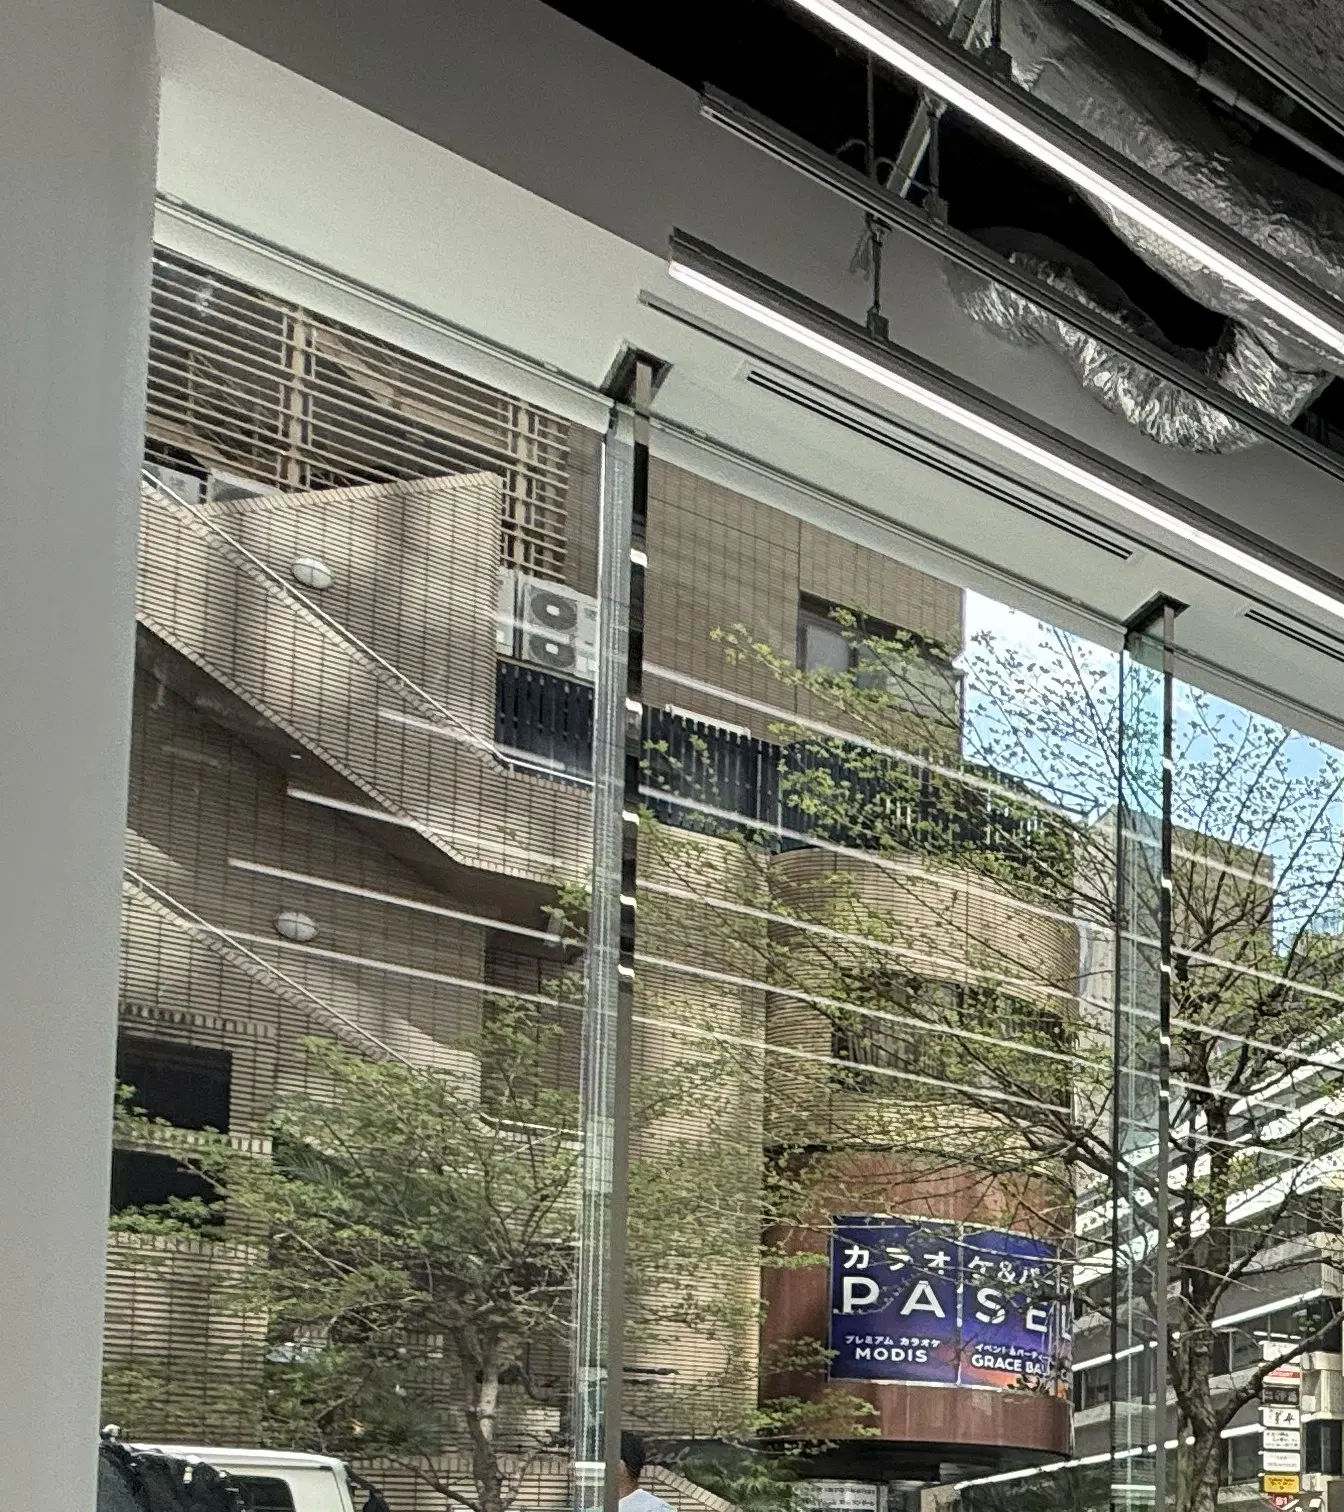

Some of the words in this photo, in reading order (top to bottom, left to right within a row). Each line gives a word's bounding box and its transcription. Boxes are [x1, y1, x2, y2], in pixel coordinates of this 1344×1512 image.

[845, 1334, 895, 1347] プレミアム
[899, 1337, 942, 1348] カラオケ
[855, 1346, 928, 1363] MODIS
[971, 1354, 1022, 1373] GRACE
